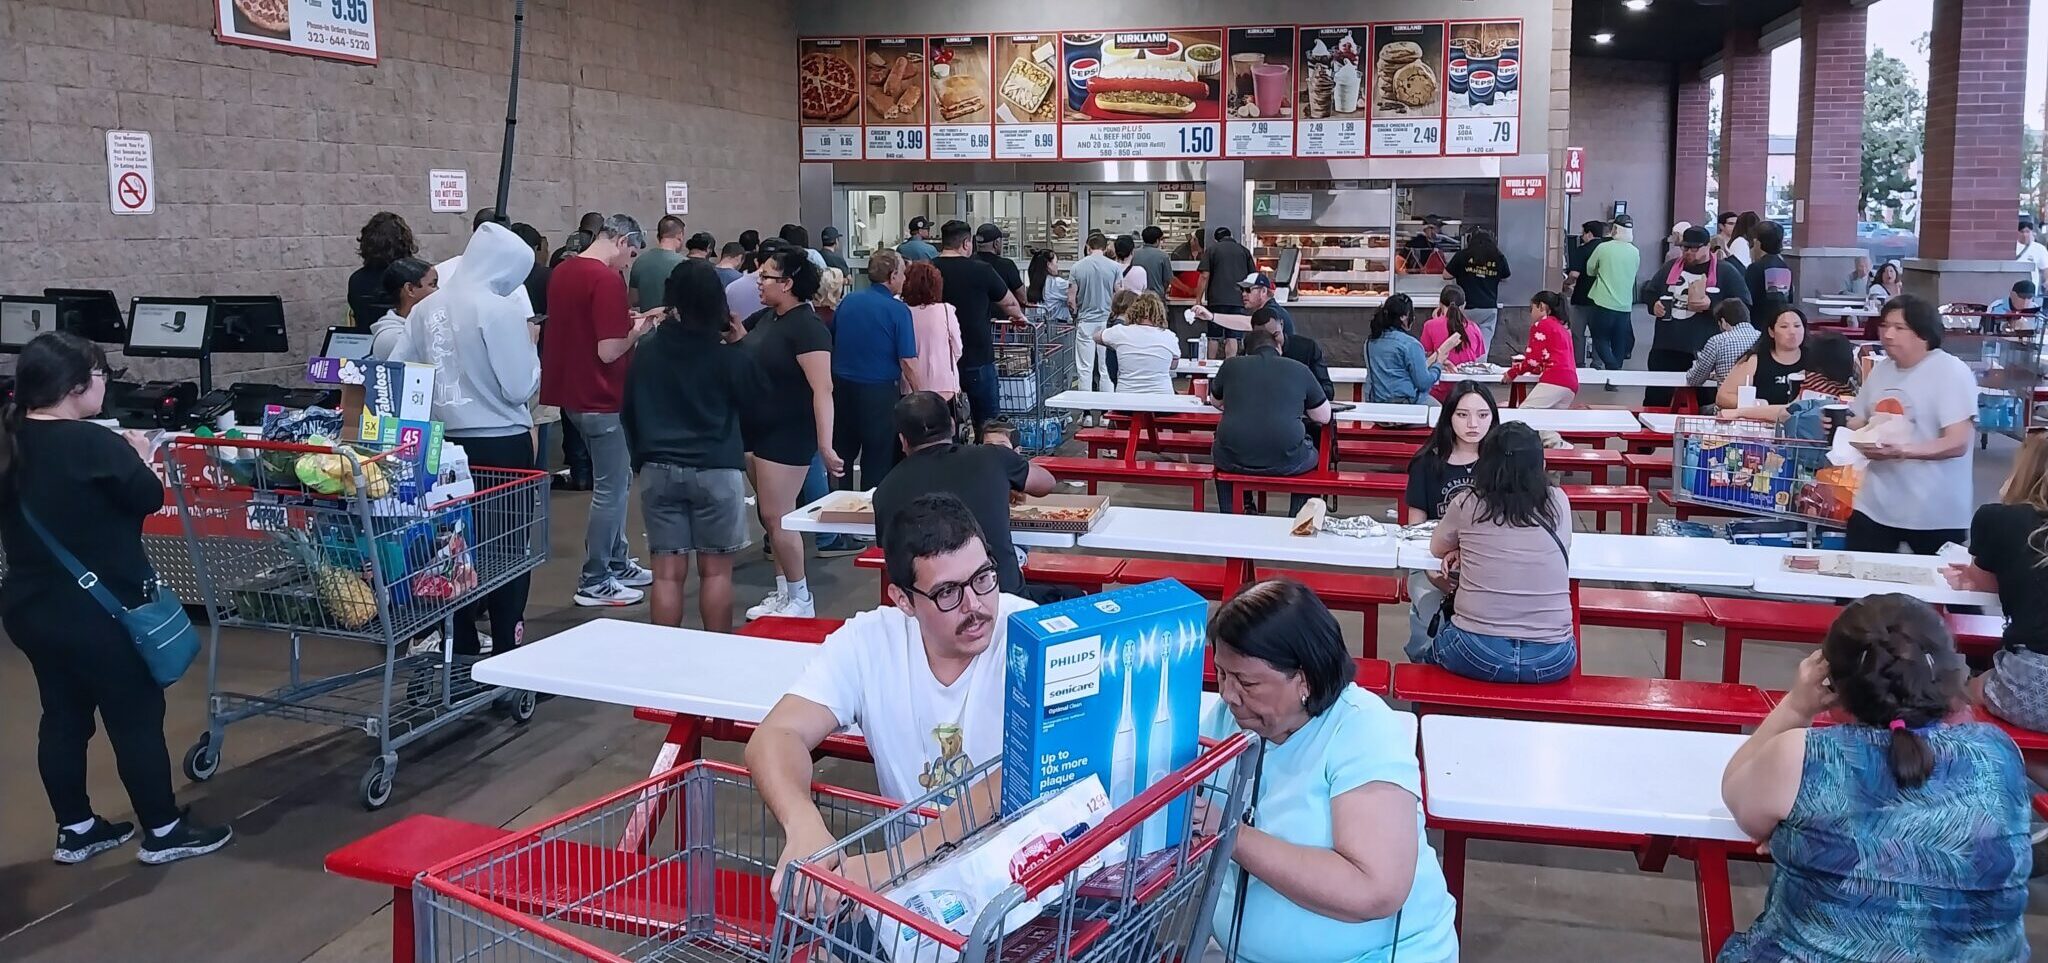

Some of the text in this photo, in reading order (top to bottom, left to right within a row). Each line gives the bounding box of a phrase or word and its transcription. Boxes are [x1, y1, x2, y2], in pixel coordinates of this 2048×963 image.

[306, 21, 369, 38] Phone-in Orders Welcome
[307, 31, 370, 51] 323-644-5220
[1116, 32, 1167, 44] KIRKLAND
[1251, 122, 1268, 134] 2.99
[1309, 123, 1323, 133] 2.49
[1341, 122, 1354, 132] 1.99
[1488, 121, 1511, 142] .79
[896, 130, 923, 149] 3.99
[970, 134, 989, 148] 6.99
[1034, 133, 1053, 147] 6.99
[1121, 132, 1134, 140] HOT
[1136, 132, 1151, 140] DOG
[1178, 126, 1214, 153] 1.50
[1413, 126, 1438, 144] 2.49
[1077, 141, 1091, 149] AND
[1092, 141, 1101, 149] 20
[1114, 141, 1132, 149] SODA
[1134, 141, 1148, 149] (With
[1570, 150, 1580, 169] &
[440, 181, 457, 189] PLEASE
[1505, 179, 1542, 187] WHOLE PIZZA
[1564, 170, 1582, 188] ON
[434, 190, 442, 198] DO
[452, 190, 464, 198] FEED
[1034, 183, 1069, 191] PICK-UP HERE
[1158, 183, 1180, 191] PICK-UP
[1511, 188, 1536, 196] PICK-UP
[438, 199, 447, 207] THE
[1255, 199, 1268, 212] A
[373, 364, 394, 418] Fabuloso
[365, 421, 377, 431] 5X
[403, 430, 419, 443] 45
[1441, 477, 1477, 495] GENUI
[1050, 650, 1096, 669] PHILIPS
[1049, 682, 1095, 699] sonicare
[1048, 704, 1069, 715] Optimal
[1041, 750, 1070, 765] Up to
[1040, 757, 1089, 777] 10x more
[1039, 772, 1076, 791] plaque
[1086, 797, 1100, 814] 12
